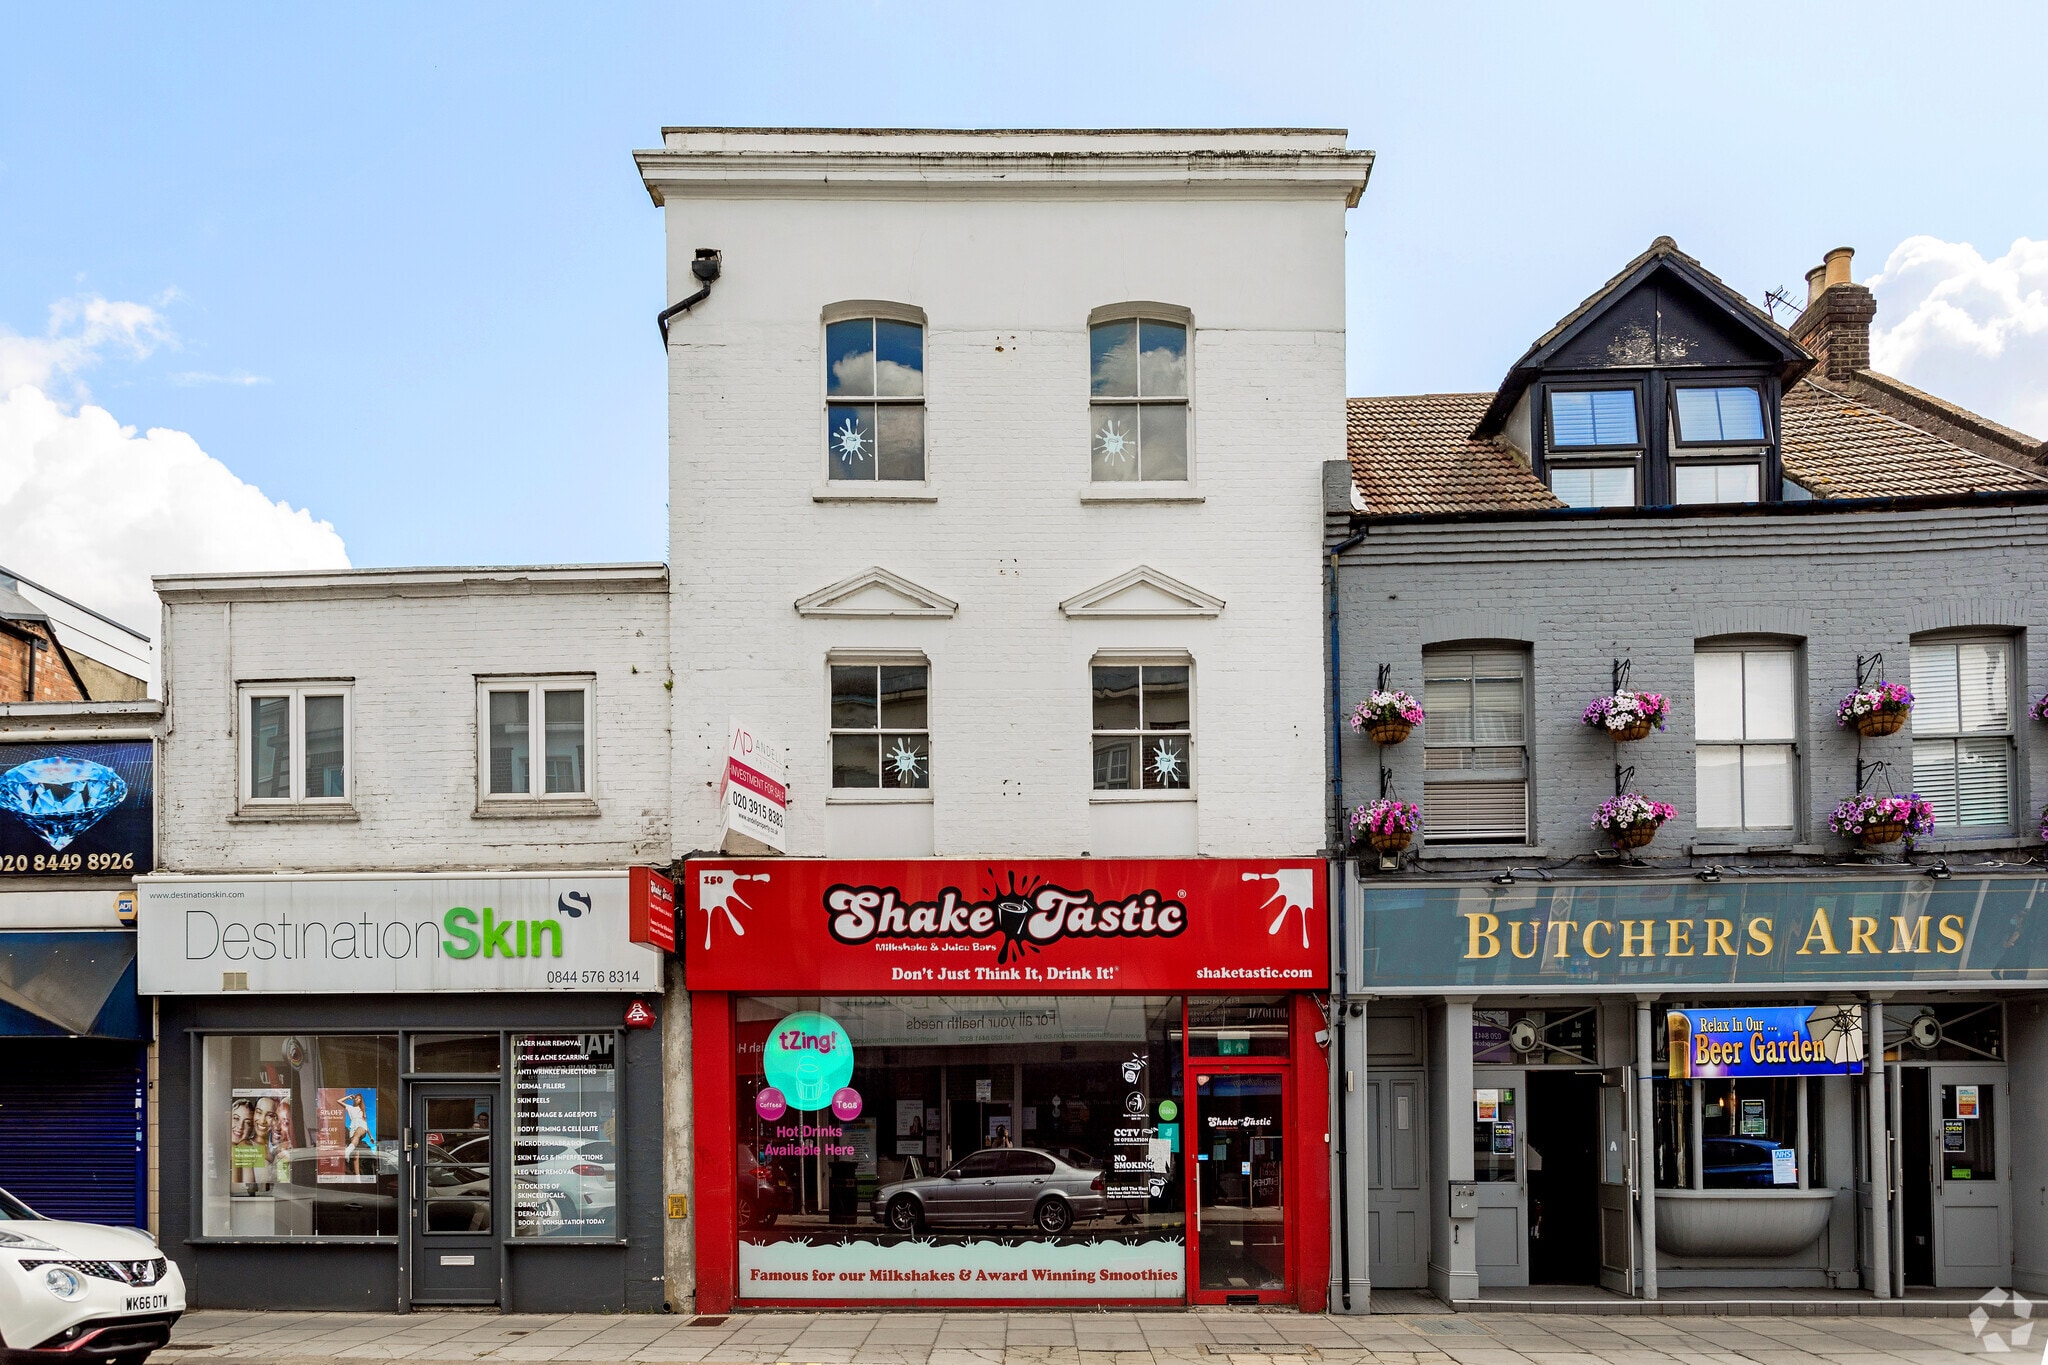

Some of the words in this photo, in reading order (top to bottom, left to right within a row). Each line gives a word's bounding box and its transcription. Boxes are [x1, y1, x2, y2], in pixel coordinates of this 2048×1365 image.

[730, 764, 764, 790] INVESTMENT
[764, 782, 774, 796] FOR
[774, 787, 784, 802] SALE
[733, 791, 747, 810] 020
[748, 798, 766, 819] 3915
[768, 808, 783, 828] 8383
[0, 854, 28, 872] 20
[33, 854, 82, 871] 8449
[87, 853, 134, 870] 8926
[704, 876, 723, 885] 150
[150, 891, 245, 899] www.destinationskin.com
[119, 900, 132, 912] ADT
[829, 890, 994, 940] Shake
[1028, 890, 1183, 940] Tastic
[1464, 912, 1774, 959] BUTCHERS
[1796, 907, 1965, 955] ARMS
[876, 943, 928, 952] Milkshake
[930, 943, 939, 952] &
[942, 943, 970, 952] Juice
[972, 943, 996, 952] Bars
[547, 970, 577, 984] 0844
[582, 970, 604, 984] 576
[609, 970, 640, 984] 8314
[892, 968, 933, 980] Don't
[938, 967, 970, 980] Just
[975, 967, 1020, 980] Think
[1026, 967, 1042, 982] It,
[1047, 967, 1091, 980] Drink
[1096, 967, 1114, 980] It!
[1197, 966, 1312, 979] shaketastic.com
[1700, 1018, 1729, 1032] Relax
[1732, 1017, 1743, 1032] In
[1746, 1017, 1764, 1032] Our
[779, 1031, 836, 1054] tZing!
[1695, 1033, 1742, 1065] Beer
[1750, 1031, 1826, 1064] Garden
[1208, 1117, 1238, 1127] Shake
[1243, 1117, 1271, 1126] Tastic
[777, 1126, 798, 1138] Hot
[804, 1126, 843, 1138] Drinks
[765, 1144, 820, 1156] Available
[825, 1144, 854, 1156] Here
[750, 1268, 808, 1282] Famous
[812, 1268, 835, 1282] for
[839, 1268, 865, 1282] our
[869, 1268, 955, 1282] Milkshakes
[959, 1268, 972, 1282] &
[975, 1268, 1028, 1282] Award
[1032, 1268, 1096, 1283] Winning
[1099, 1268, 1178, 1282] Smoothies
[126, 1296, 150, 1311] WK66
[153, 1295, 167, 1308] OTW
